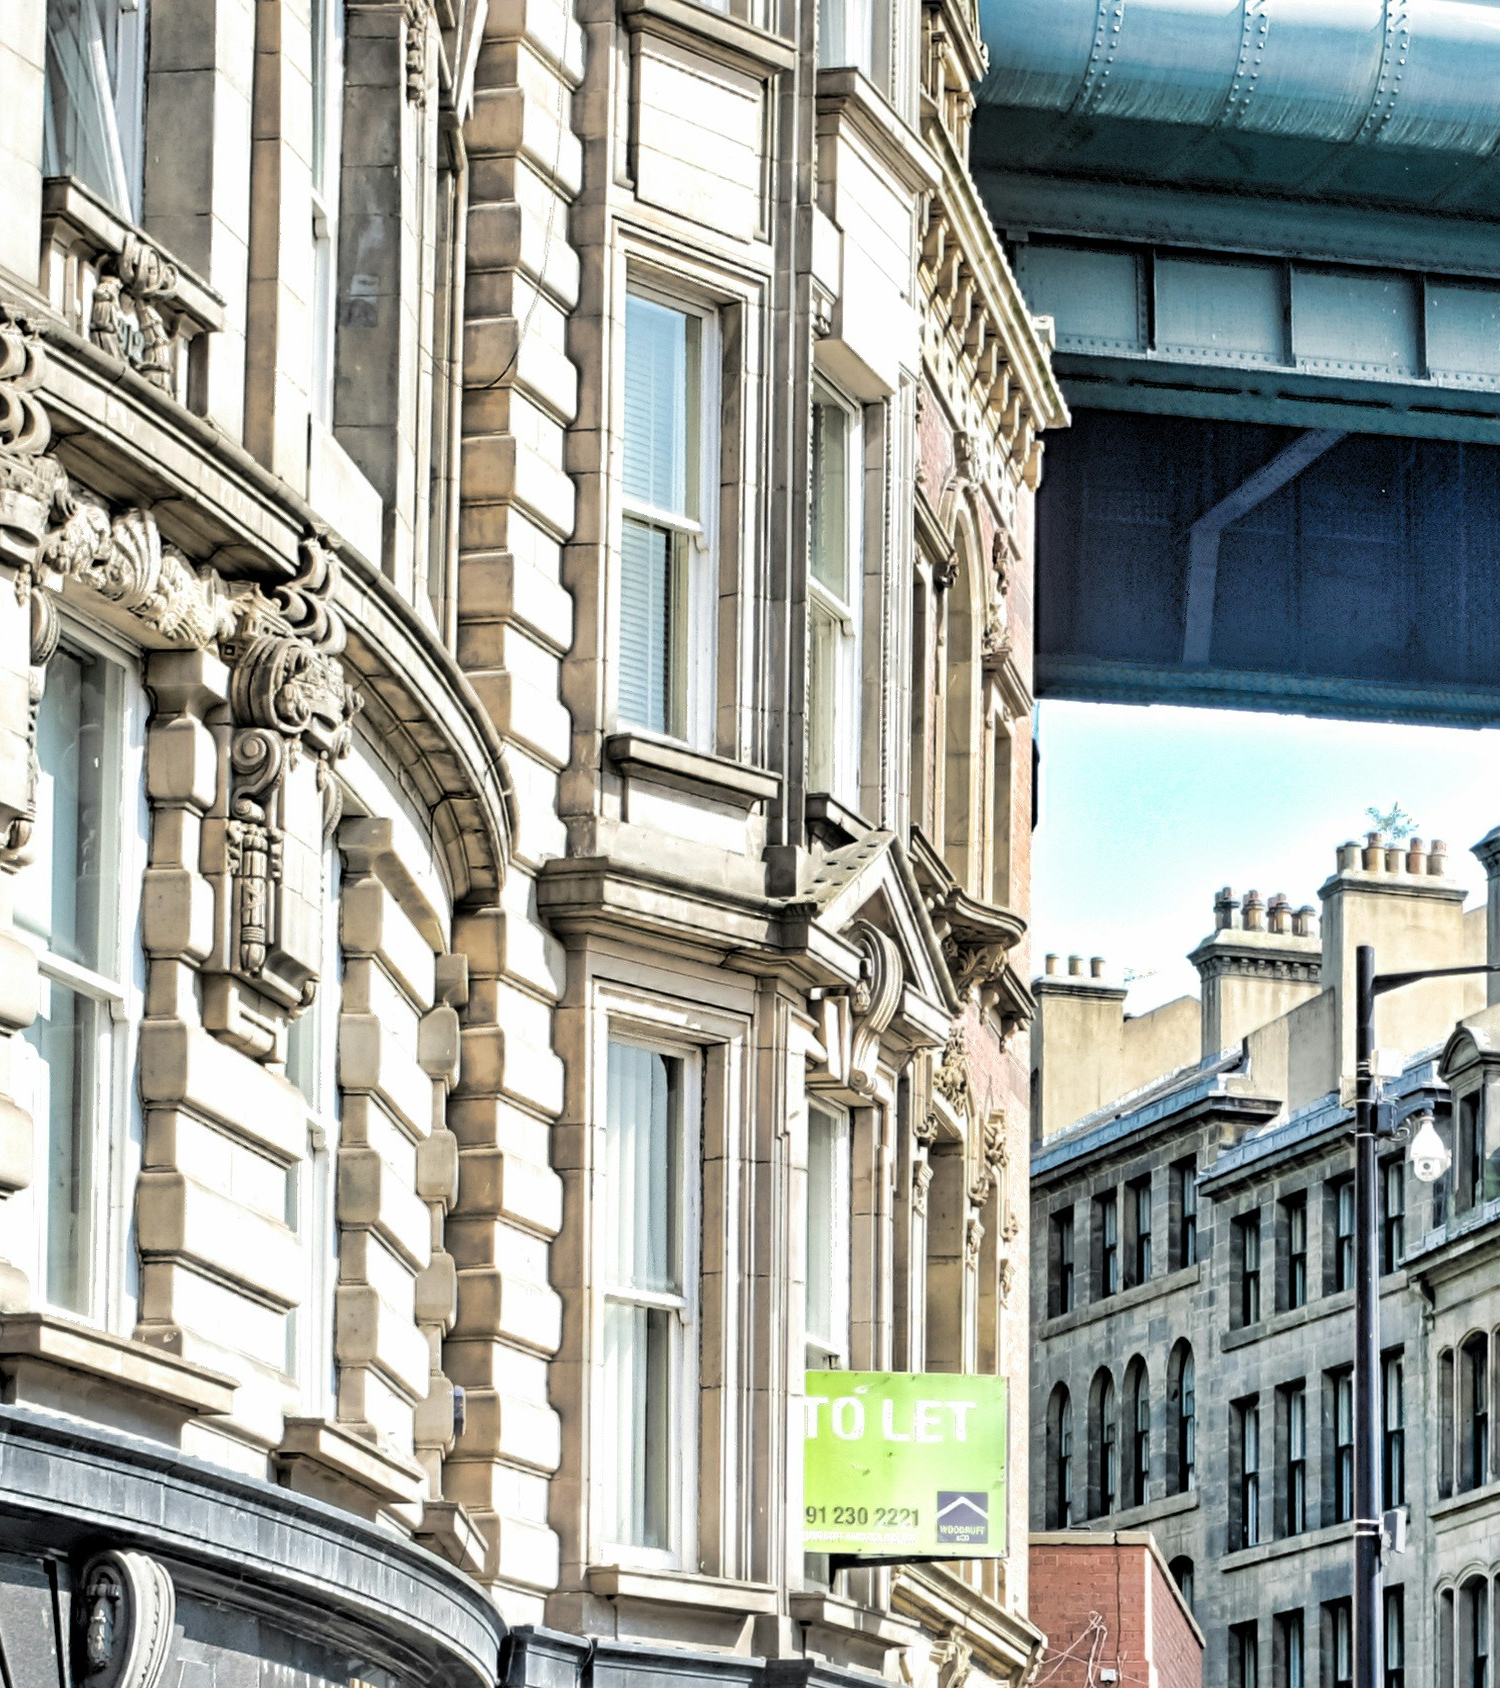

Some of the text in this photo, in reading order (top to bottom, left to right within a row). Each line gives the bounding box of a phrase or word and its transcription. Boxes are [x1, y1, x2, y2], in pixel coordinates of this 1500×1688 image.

[804, 1396, 977, 1443] TO LET
[833, 1506, 869, 1525] 230
[875, 1507, 919, 1527] 2221
[939, 1524, 986, 1535] WOODRUFF
